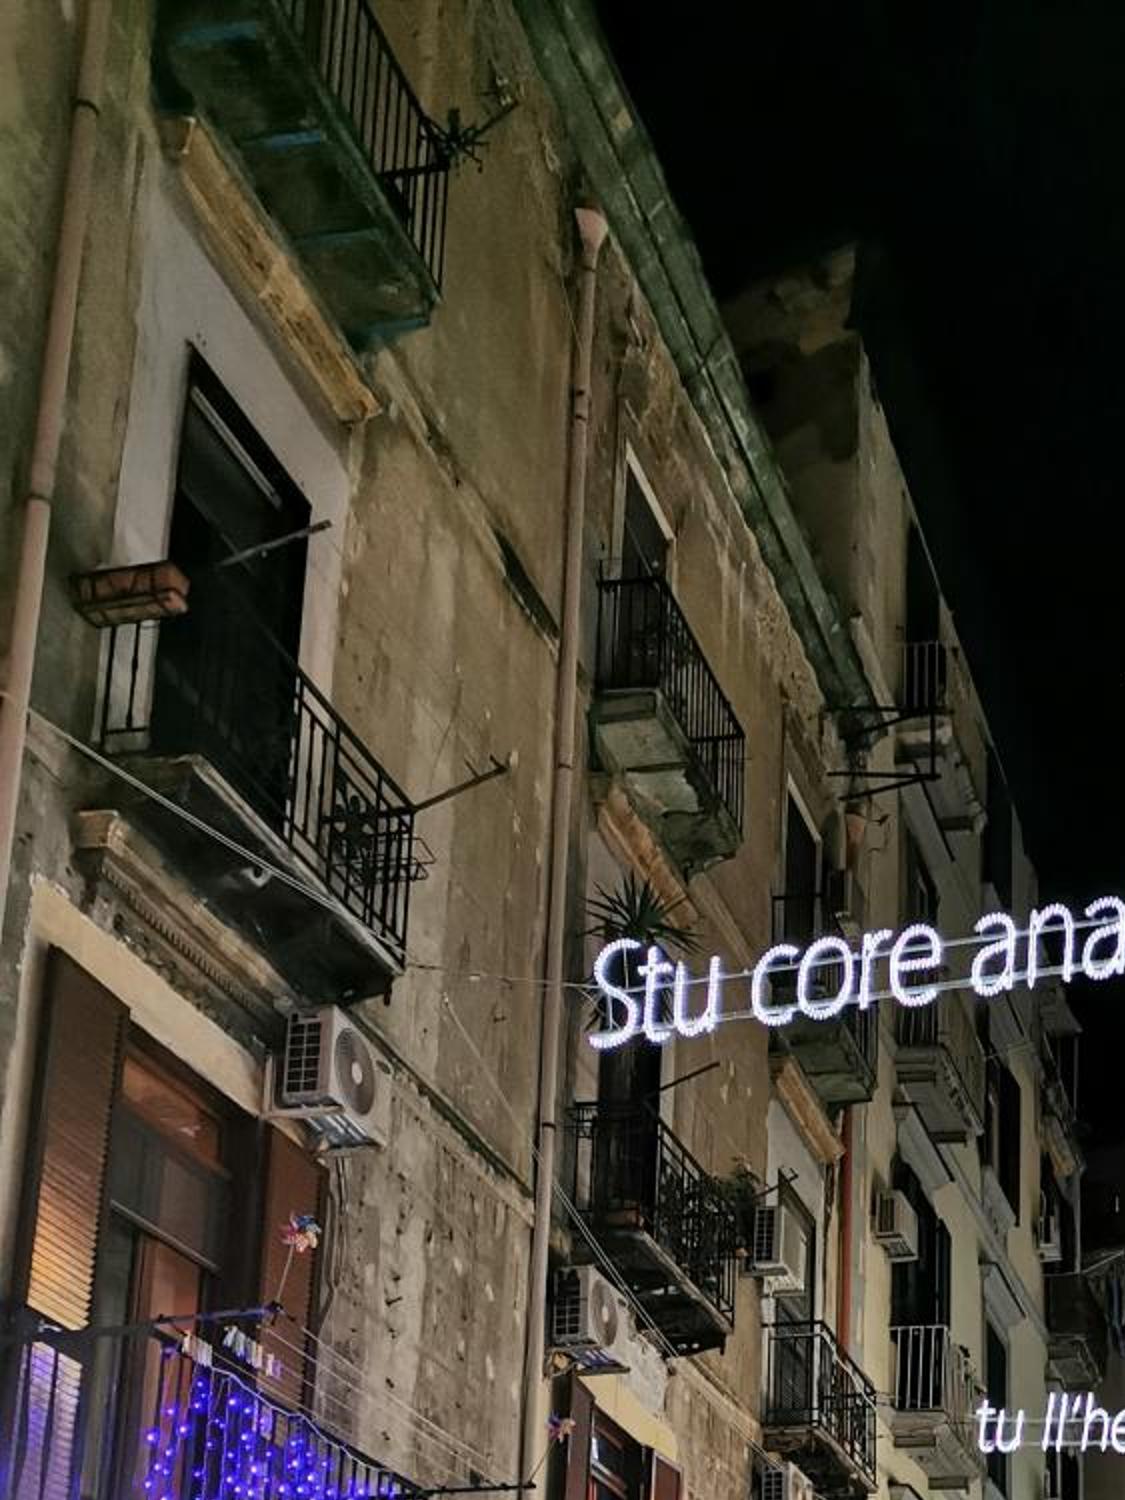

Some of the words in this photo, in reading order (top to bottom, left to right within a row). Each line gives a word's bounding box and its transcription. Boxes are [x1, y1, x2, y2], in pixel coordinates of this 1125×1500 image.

[589, 937, 722, 1049] Stu
[750, 923, 942, 1027] core
[975, 1399, 1025, 1454] tu
